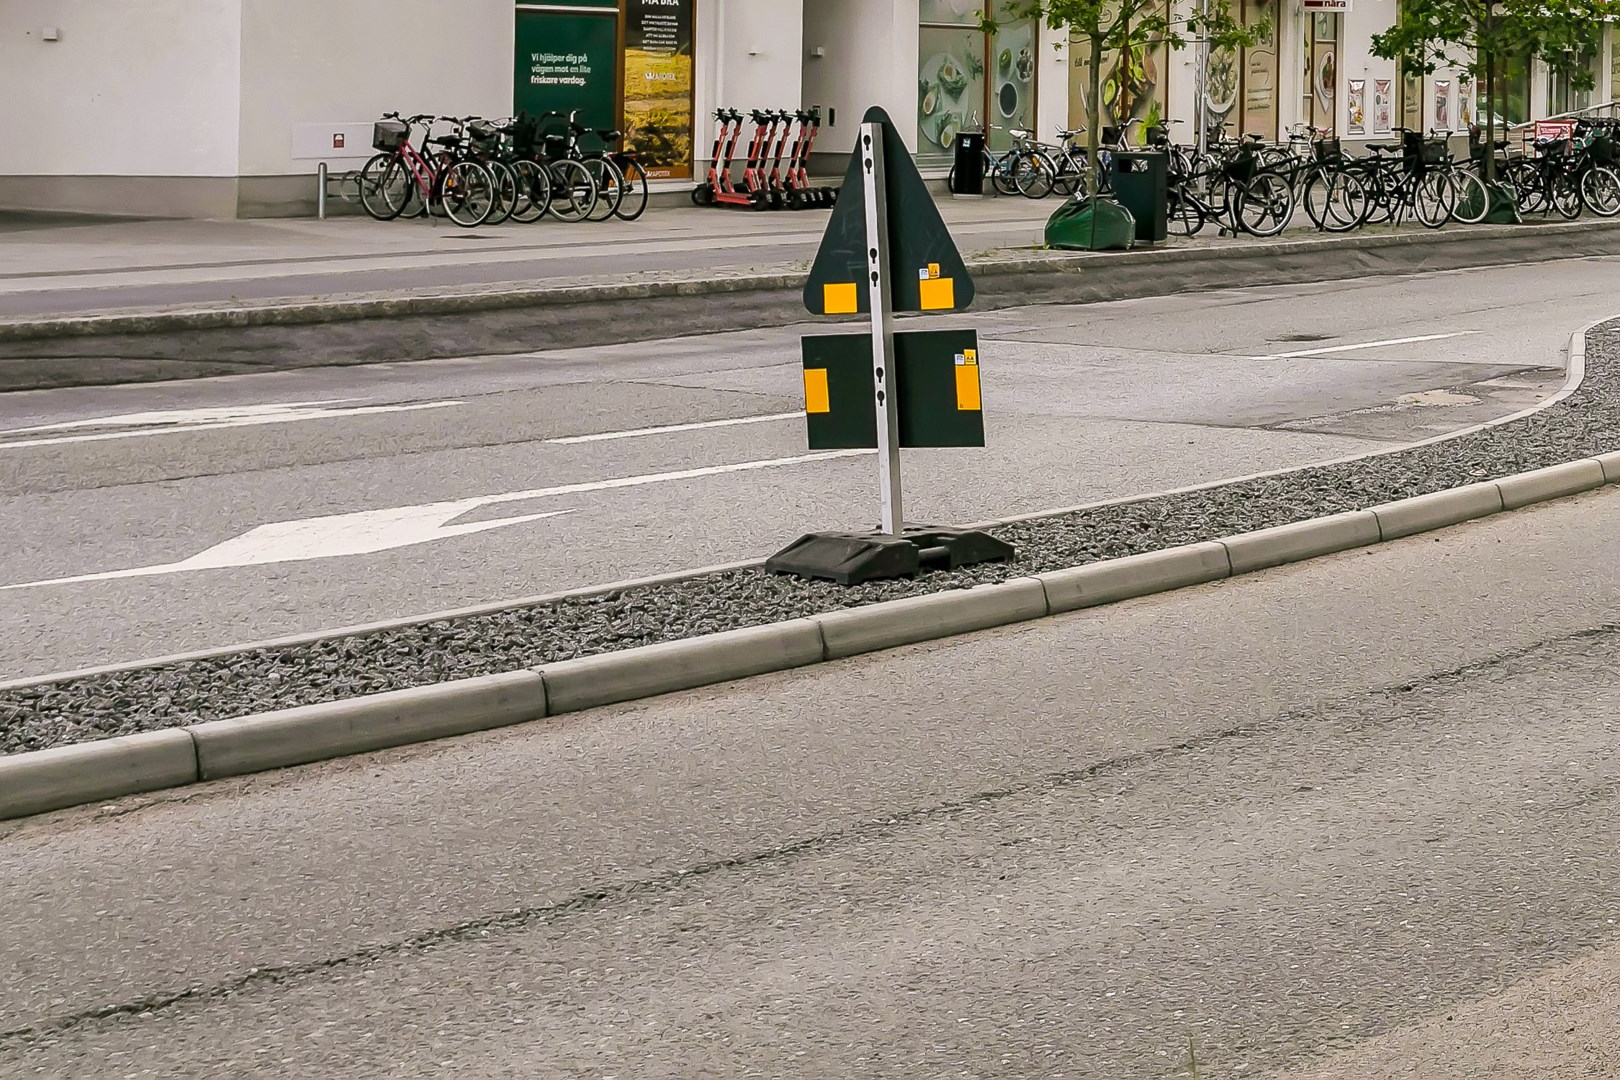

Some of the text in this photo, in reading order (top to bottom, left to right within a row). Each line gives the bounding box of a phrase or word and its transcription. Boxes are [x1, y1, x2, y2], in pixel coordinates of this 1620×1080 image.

[1324, 0, 1346, 8] nära
[531, 53, 588, 64] Vi hjälper dig på
[531, 64, 554, 75] vägen
[530, 75, 559, 84] friskare
